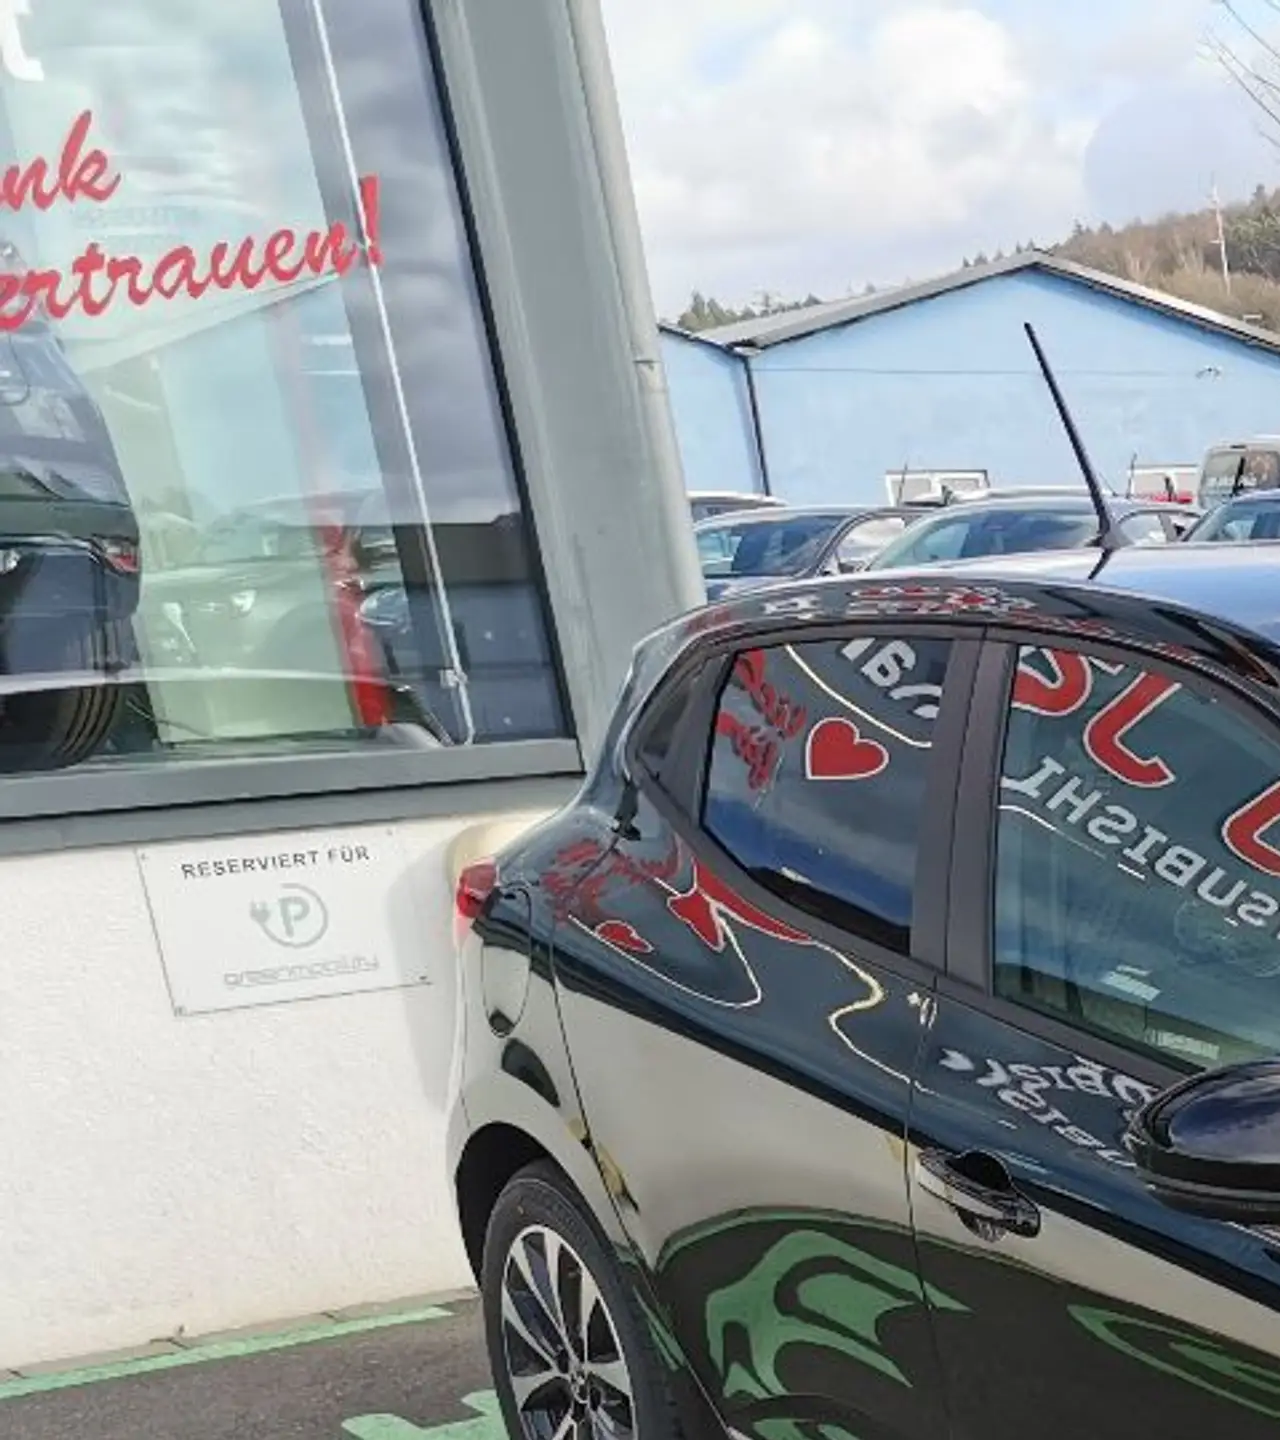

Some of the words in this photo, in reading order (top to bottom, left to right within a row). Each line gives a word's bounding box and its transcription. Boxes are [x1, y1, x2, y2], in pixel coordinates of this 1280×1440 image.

[0, 109, 121, 211] nk
[181, 850, 319, 879] RESERVIERT
[327, 845, 371, 863] FÜR
